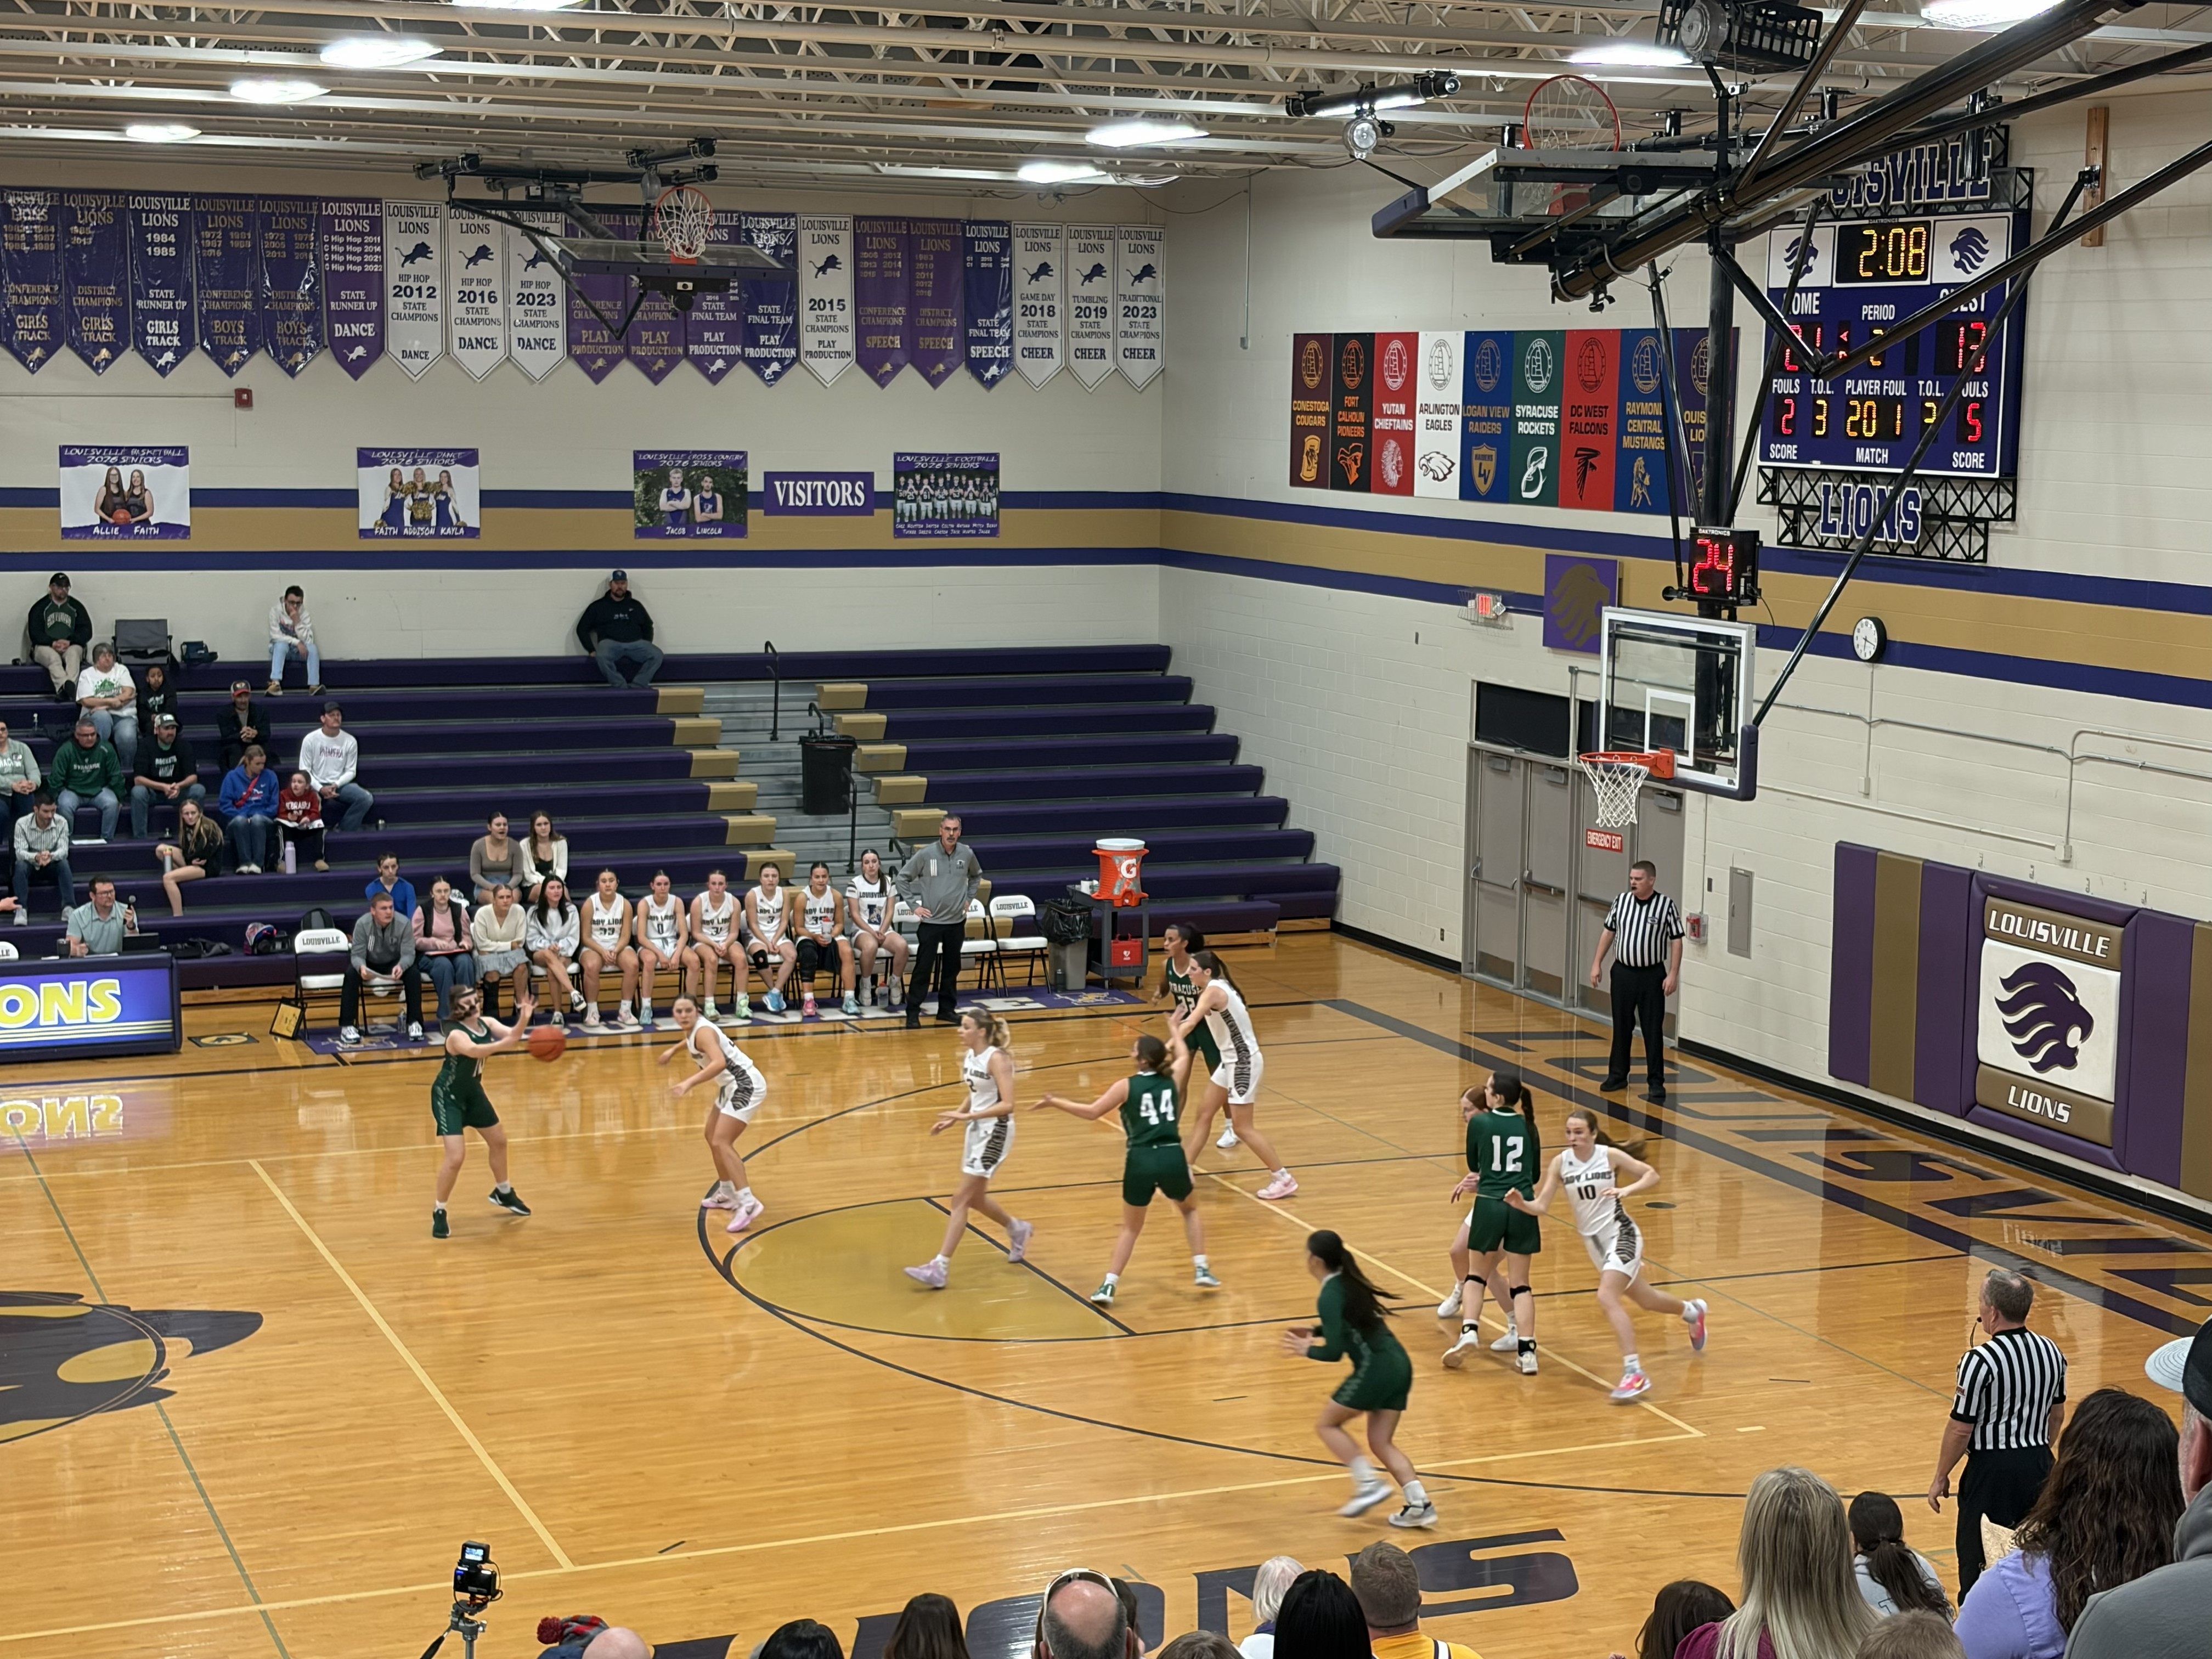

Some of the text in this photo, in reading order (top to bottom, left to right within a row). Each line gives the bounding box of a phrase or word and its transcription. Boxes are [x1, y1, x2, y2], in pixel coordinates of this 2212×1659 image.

[129, 196, 191, 211] LOUISVILLE
[322, 202, 381, 216] LOUISVILLE
[388, 205, 439, 218] LOUISVILLE
[142, 213, 178, 227] LIONS
[335, 219, 370, 232] LIONS
[802, 220, 849, 231] LOUISVILLE
[398, 222, 429, 234] LIONS
[460, 223, 490, 234] LIONS
[1015, 228, 1060, 239] LOUISVILLE
[1069, 229, 1113, 240] LOUISVILLE
[145, 233, 176, 243] 1984
[331, 235, 344, 244] Hip
[346, 235, 362, 244] Hop
[812, 234, 839, 244] LIONS
[1120, 230, 1163, 241] LOUISVILLE
[146, 247, 176, 256] 1985
[331, 245, 344, 253] Hip
[346, 245, 362, 253] Hop
[1025, 241, 1051, 252] LIONS
[1078, 243, 1104, 253] LIONS
[1128, 244, 1155, 254] LIONS
[1859, 227, 1927, 277] 2:08
[331, 254, 344, 262] Hip
[346, 255, 362, 263] Hop
[331, 263, 345, 272] Hip
[347, 264, 362, 272] Hop
[149, 290, 175, 298] STATE
[341, 291, 366, 299] STATE
[392, 285, 437, 299] 2012
[458, 290, 498, 303] 2016
[516, 293, 556, 306] 2023
[809, 298, 845, 312] 2015
[1784, 292, 1820, 315] OME
[331, 302, 377, 311] RUNNER UP
[403, 302, 427, 311] STATE
[758, 305, 781, 313] STATE
[1021, 304, 1056, 318] 2018
[1075, 306, 1107, 319] 2019
[1122, 306, 1156, 318] 2023
[1862, 304, 1895, 321] PERIOD
[391, 313, 438, 321] CHAMPIONS
[454, 318, 501, 326] CHAMPIONS
[147, 320, 178, 334] GIRLS
[334, 323, 375, 337] DANCE
[146, 336, 181, 346] TRACK
[459, 337, 498, 349] DANCE
[641, 331, 669, 344] PLAY
[704, 332, 725, 341] PLAY
[760, 335, 781, 345] PLAY
[517, 337, 556, 350] DANCE
[402, 349, 430, 360] DANCE
[689, 345, 742, 356] PRODUCTION
[744, 348, 797, 358] PRODUCTION
[1022, 347, 1054, 359] CHEER
[1074, 348, 1107, 360] CHEER
[1122, 348, 1155, 360] CHEER
[1773, 379, 1800, 394] FOULS
[1810, 379, 1835, 394] T.O.L.
[1846, 380, 1907, 396] PLAYER FOUL
[1918, 381, 1944, 397] T.O.L.
[1962, 382, 1988, 398] OULS
[1293, 400, 1329, 413] CONESTOGA
[1344, 396, 1359, 408] FORT
[1382, 403, 1406, 415] YUTAN
[1419, 403, 1460, 416] ARLINGTON
[1463, 405, 1510, 418] LOGAN VIEW
[1515, 405, 1559, 419] SYRACUSE
[1570, 405, 1609, 419] DC WEST
[1296, 415, 1325, 427] COUGARS
[1338, 411, 1364, 423] CALHOUN
[1782, 399, 1795, 435] 2
[1815, 400, 1827, 435] 3
[1847, 400, 1876, 437] 20
[1896, 404, 1901, 435] 1
[1967, 403, 1982, 442] 5
[1337, 426, 1364, 437] PIONEERS
[1374, 419, 1413, 431] CHIEFTAINS
[1426, 419, 1452, 431] EAGLES
[1469, 421, 1502, 434] RAIDERS
[1517, 422, 1555, 435] ROCKETS
[1569, 421, 1608, 435] FALCONS
[1627, 420, 1662, 433] CENTRAL
[1623, 436, 1665, 450] MUSTANGS
[64, 448, 126, 456] LOUISVILLE
[1770, 443, 1985, 469] SCORE MATCH SCORE
[774, 481, 865, 507] VISITORS
[1819, 482, 1922, 544] LIONS
[93, 526, 159, 535] ALLIE FAITH
[374, 526, 465, 536] FAITH ADDISON KAYLA
[665, 527, 686, 535] JACOB
[1699, 528, 1730, 537] DAKTRONICS
[1693, 539, 1734, 593] 24
[1587, 831, 1622, 850] EMERGENCY EXIT
[1121, 859, 1137, 878] G
[996, 902, 1029, 911] LOUISVILLE
[1988, 910, 2110, 958] LOUISVILLE
[302, 936, 340, 946] LOUISVILLE
[1140, 1088, 1175, 1125] 44
[2007, 1085, 2072, 1123] LIONS
[1491, 1135, 1523, 1172] 12
[1577, 1184, 1596, 1200] 10
